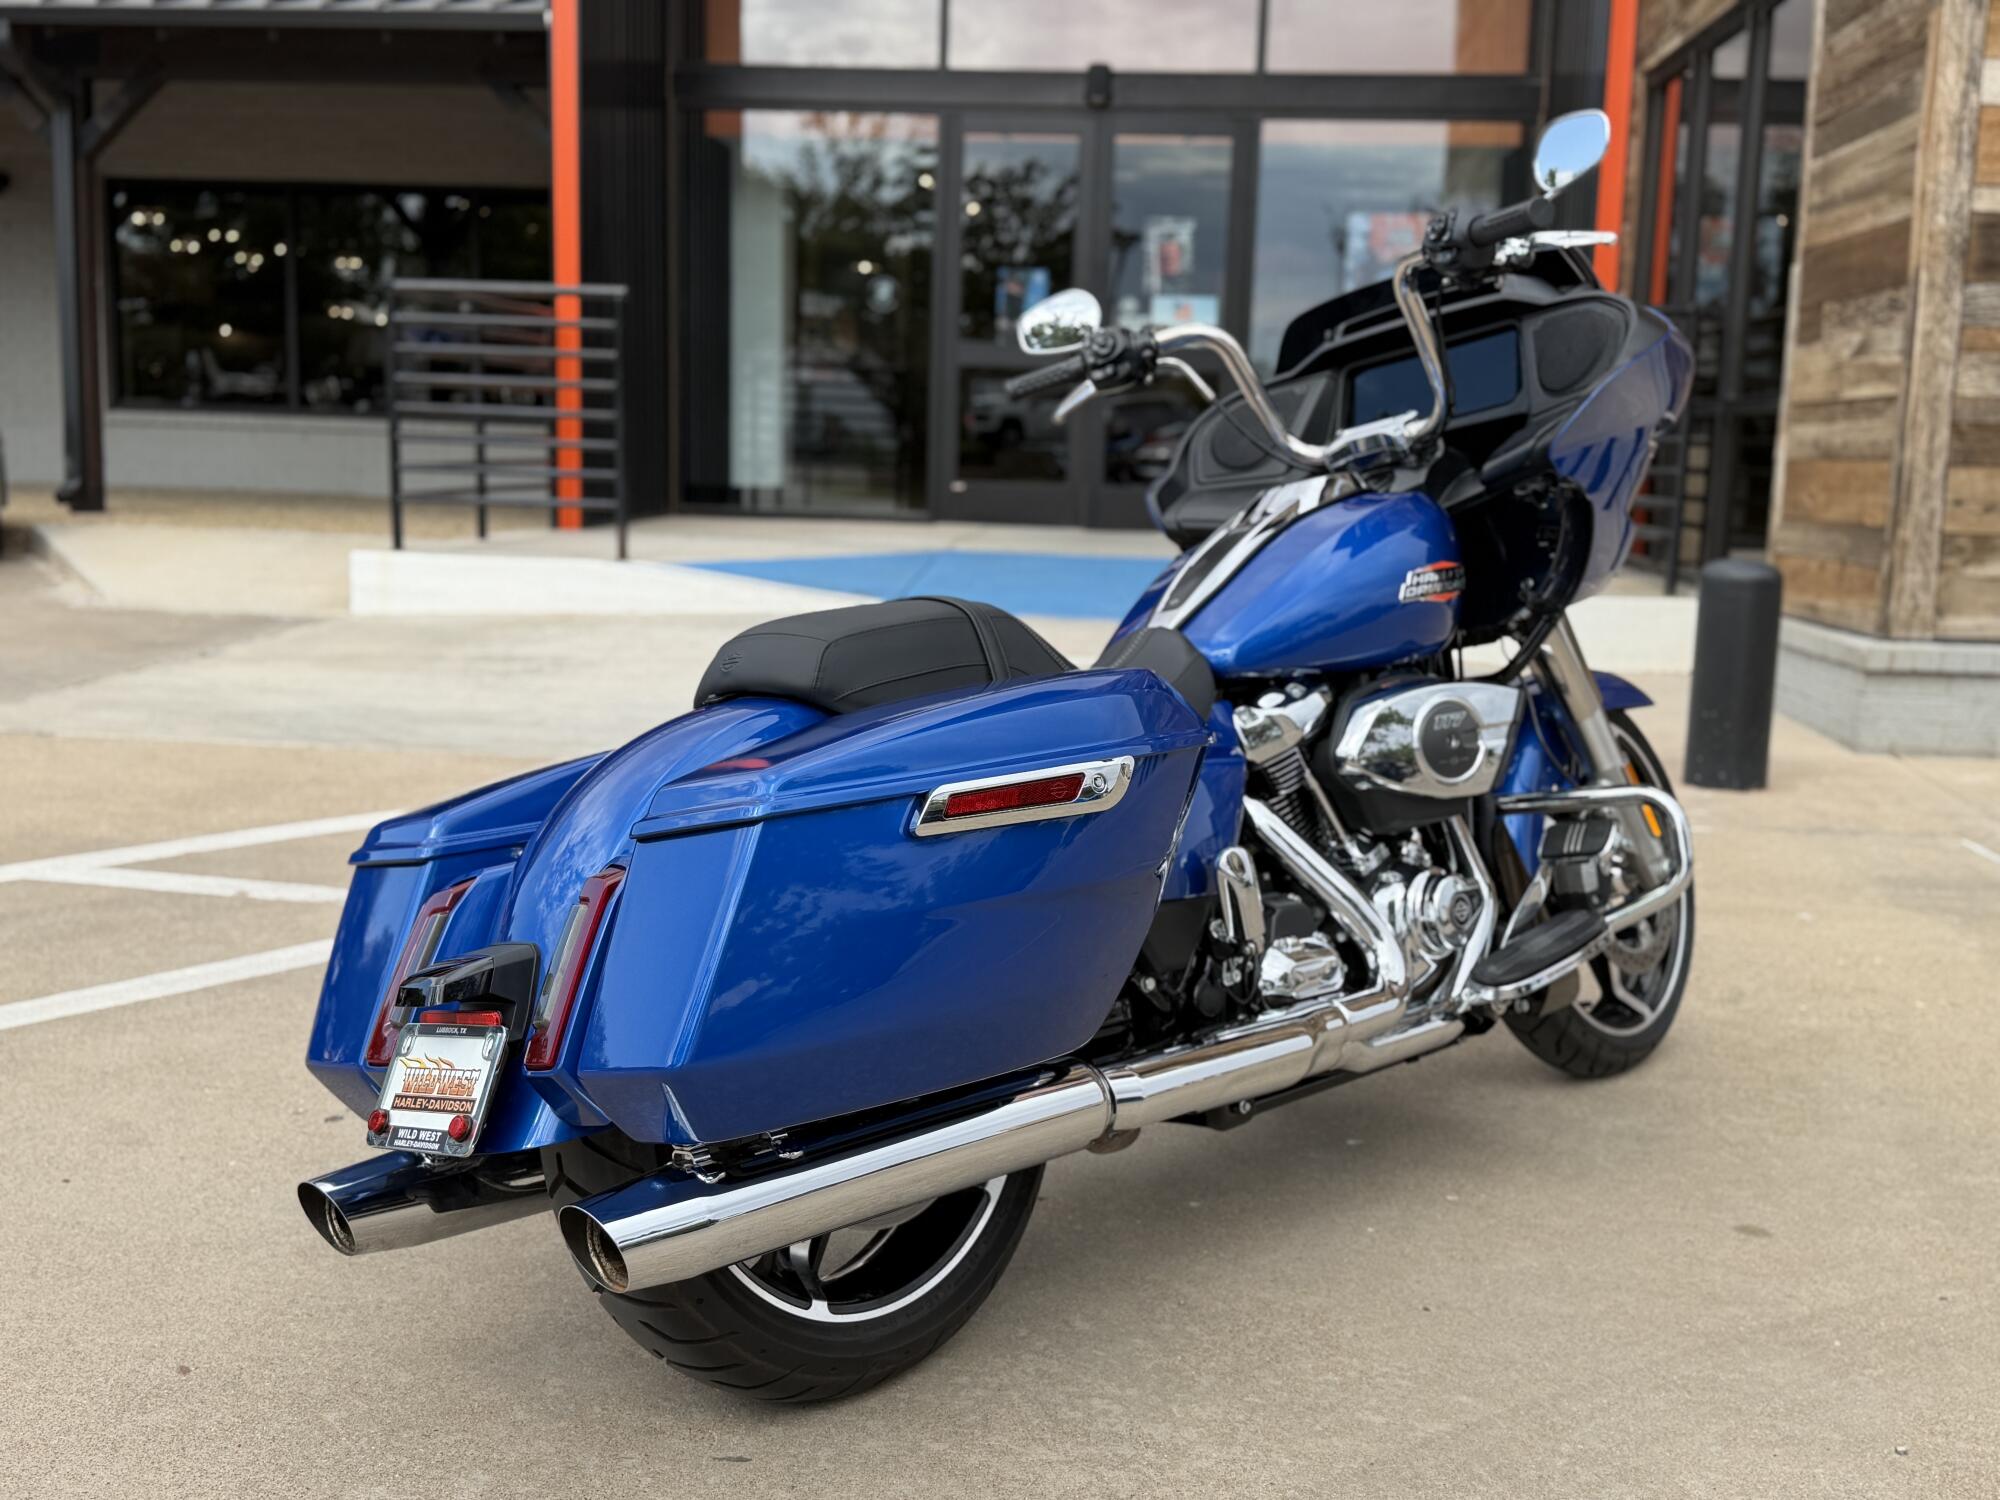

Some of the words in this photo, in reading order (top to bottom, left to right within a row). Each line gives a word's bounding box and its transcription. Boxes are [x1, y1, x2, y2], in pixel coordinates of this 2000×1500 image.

[401, 1067, 437, 1095] WILD
[437, 1068, 481, 1097] WEST
[393, 1096, 474, 1112] HARLEY-DAVIDSON
[398, 1128, 418, 1140] WILD
[419, 1130, 442, 1142] WEST
[393, 1139, 440, 1150] HARLEY-DAVIDSON
